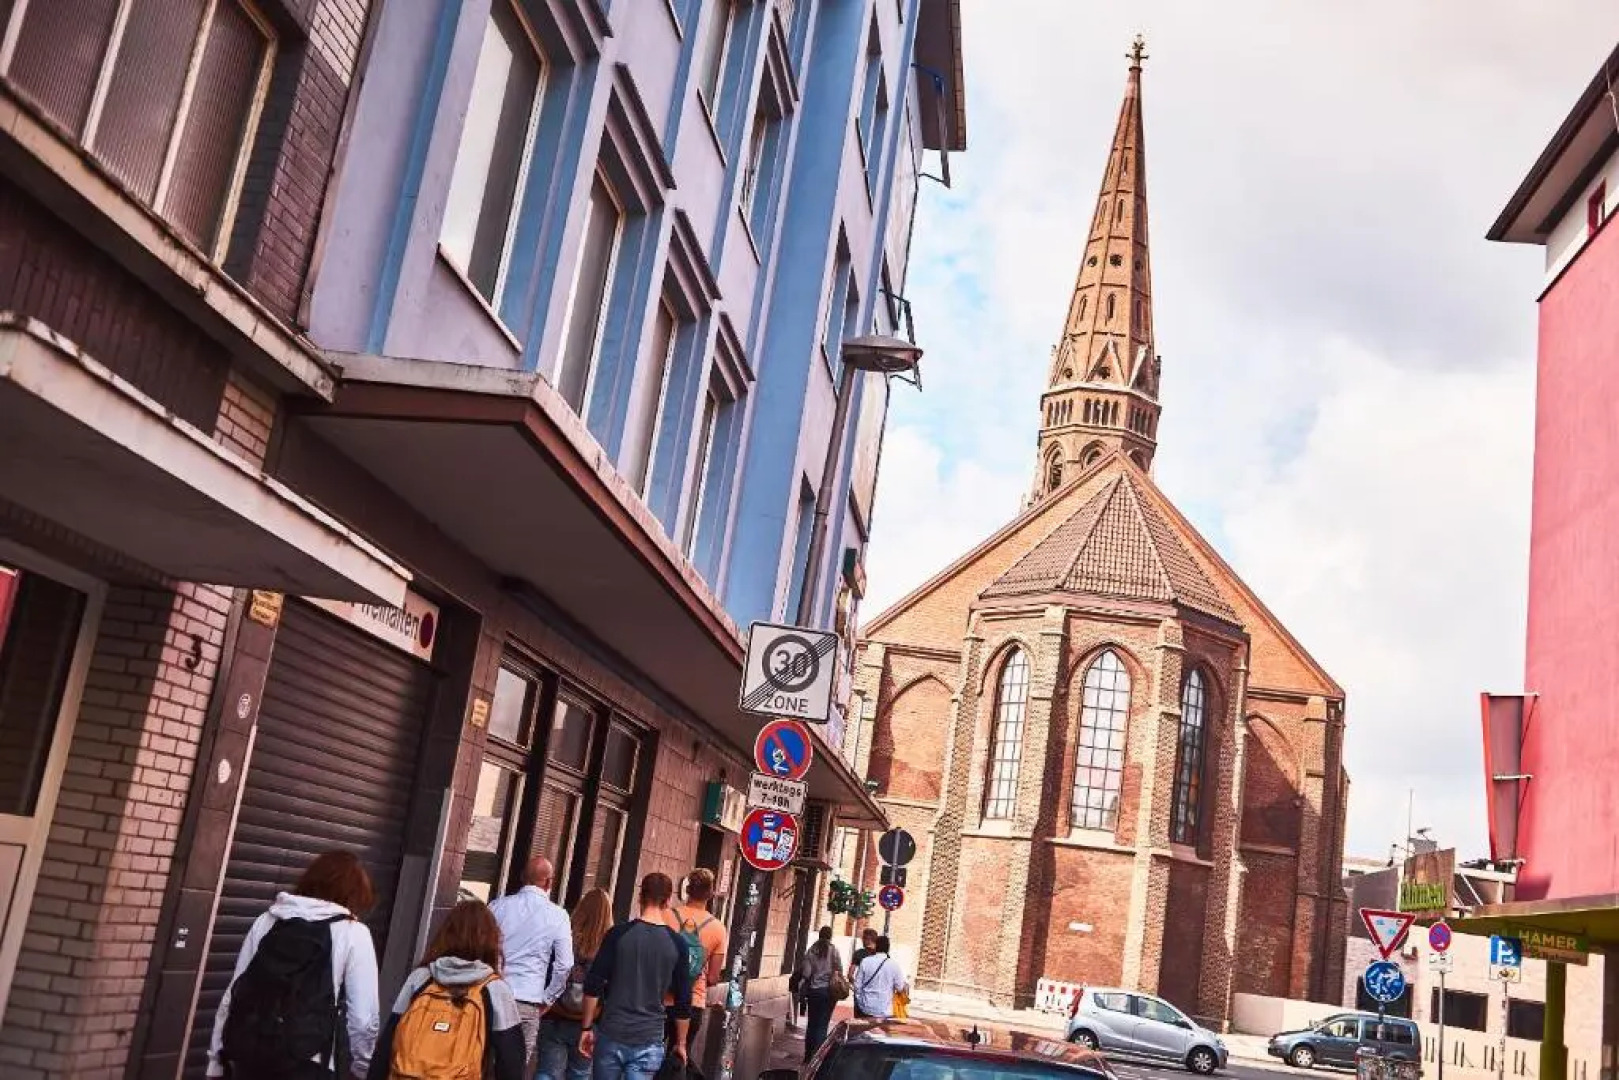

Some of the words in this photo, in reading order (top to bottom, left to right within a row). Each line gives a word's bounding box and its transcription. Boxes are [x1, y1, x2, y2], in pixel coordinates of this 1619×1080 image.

[185, 634, 203, 670] 3
[774, 649, 808, 678] 30
[763, 693, 809, 714] ZONE
[1518, 930, 1577, 950] HAMER
